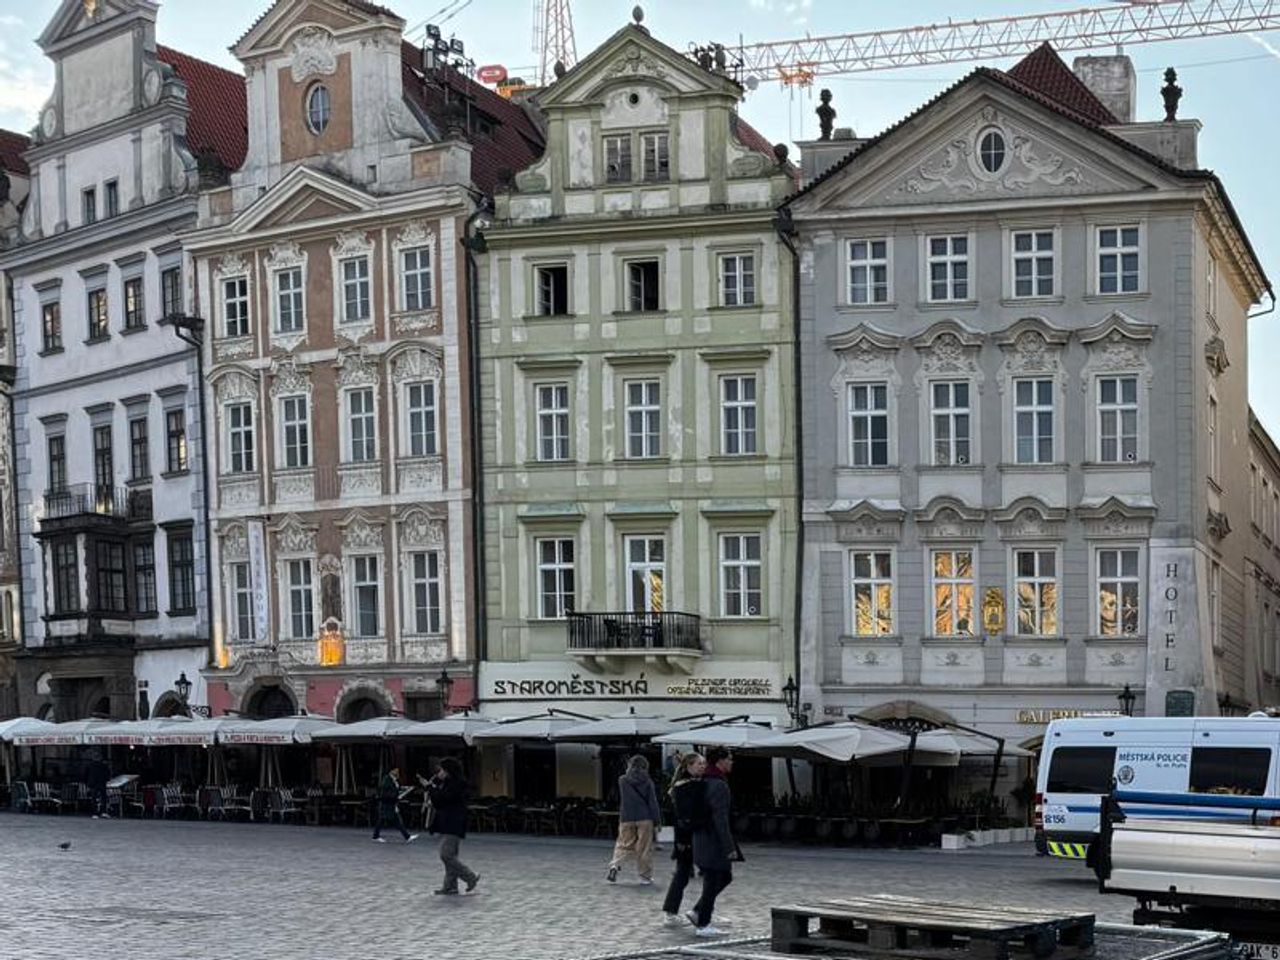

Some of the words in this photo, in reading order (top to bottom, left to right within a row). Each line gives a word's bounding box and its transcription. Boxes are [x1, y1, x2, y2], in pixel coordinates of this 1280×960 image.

[1164, 563, 1178, 672] HOTEL
[494, 672, 649, 695] STAROMĚSTSKÁ
[1156, 753, 1189, 762] POLICIE
